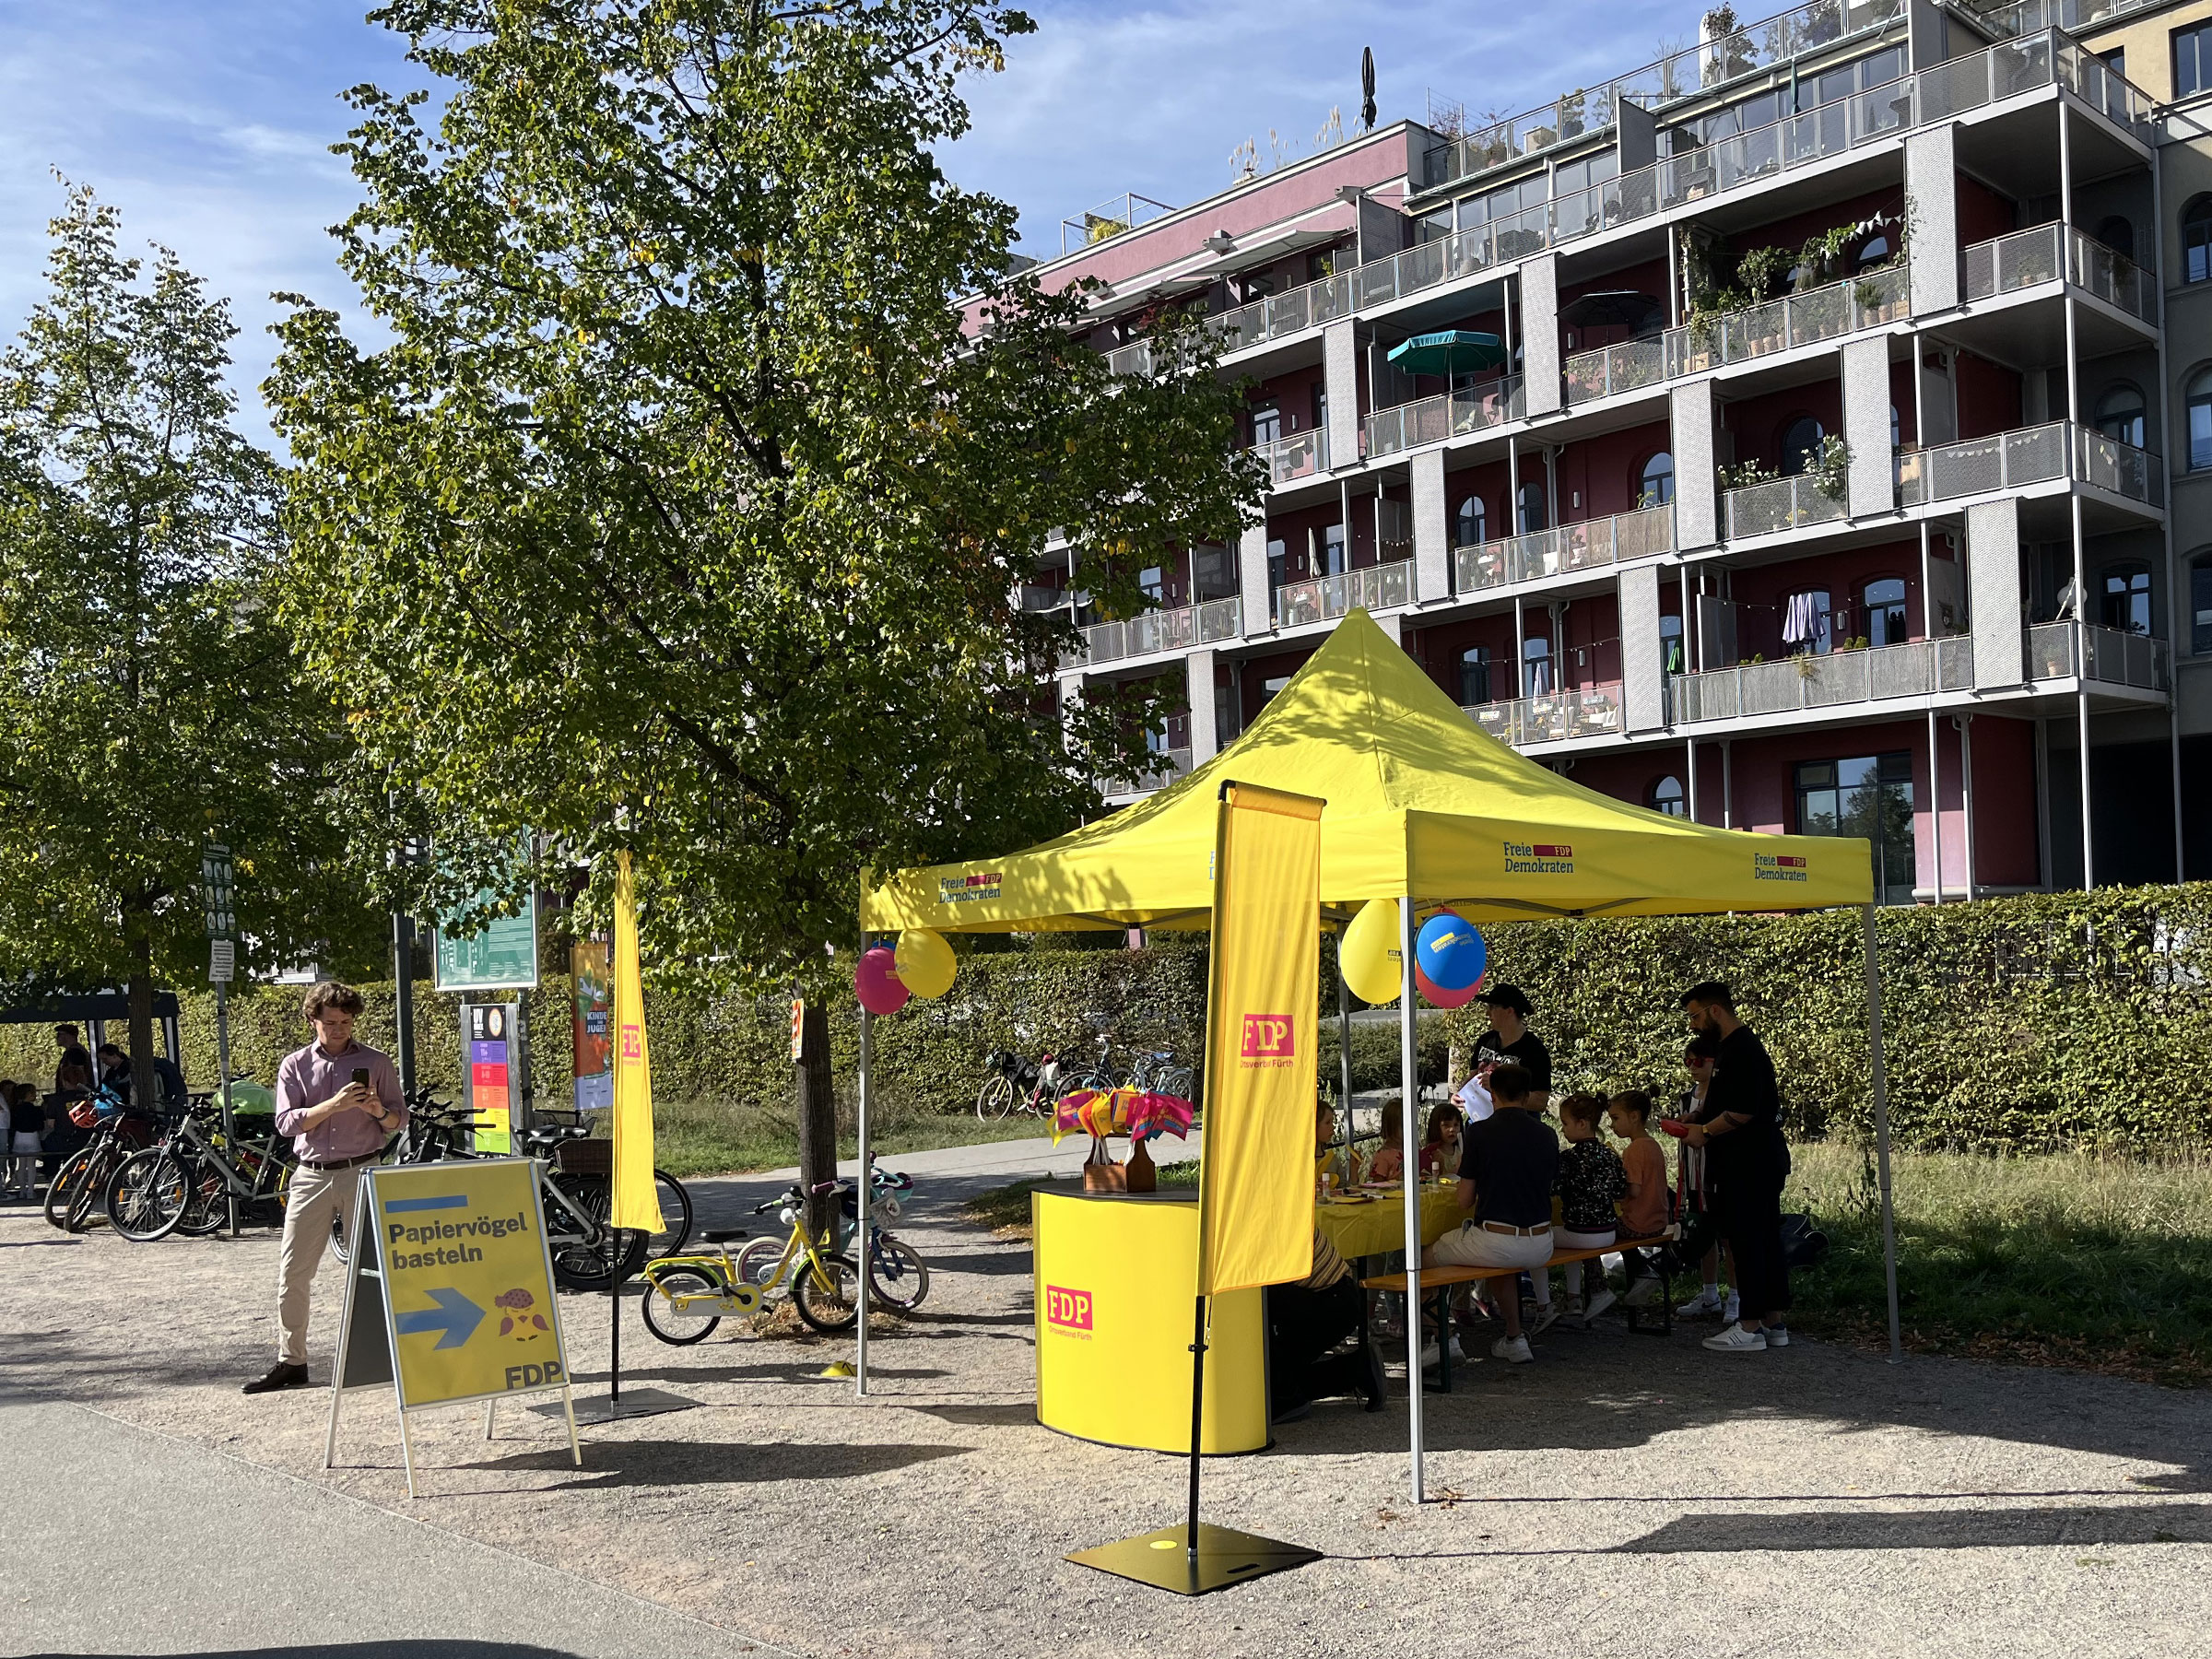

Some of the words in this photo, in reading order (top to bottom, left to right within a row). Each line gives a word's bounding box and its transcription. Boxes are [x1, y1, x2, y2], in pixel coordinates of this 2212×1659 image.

[1503, 841, 1532, 856] Freie
[1554, 846, 1571, 856] FDP
[1504, 858, 1573, 873] Demokraten
[1755, 853, 1776, 865] Freie
[1793, 858, 1806, 866] FDP
[1755, 867, 1806, 881] Demokraten
[941, 877, 965, 889] Freie
[985, 875, 1001, 884] FDP
[939, 888, 1001, 903] Demokraten
[1243, 1020, 1288, 1051] FDP
[1272, 1059, 1293, 1067] Fürth
[389, 1212, 528, 1244] Papiervögel
[392, 1243, 483, 1270] basteln
[1049, 1290, 1089, 1324] FDP
[505, 1360, 561, 1390] FDP
